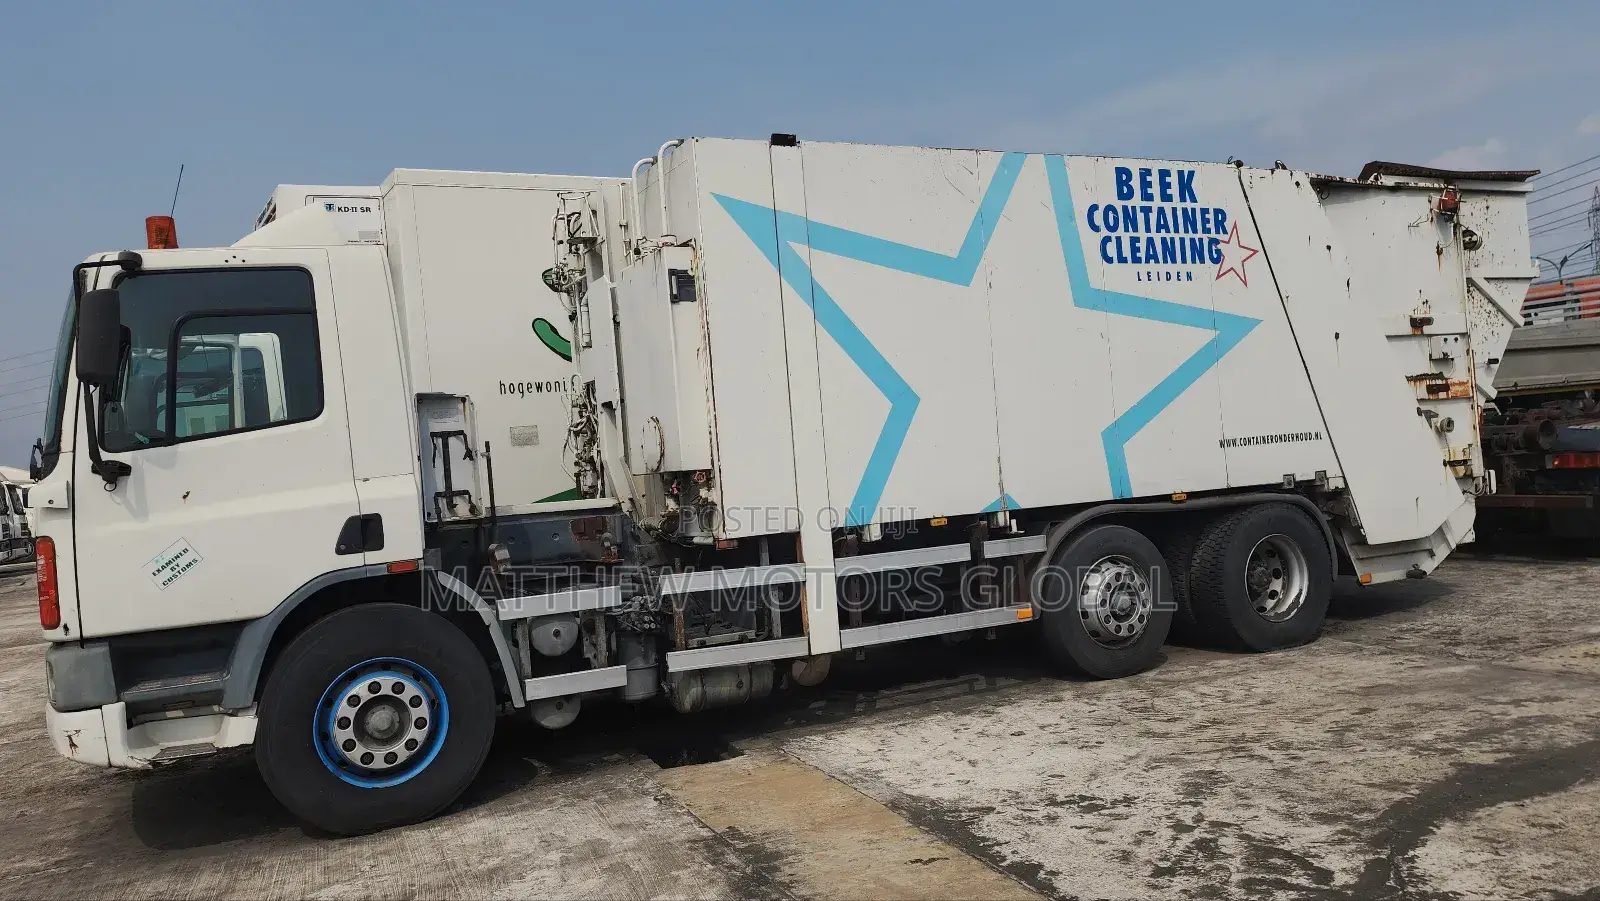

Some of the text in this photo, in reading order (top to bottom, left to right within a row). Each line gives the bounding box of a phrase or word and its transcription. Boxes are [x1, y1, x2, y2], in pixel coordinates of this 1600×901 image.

[1114, 166, 1198, 204] BEEK
[1086, 203, 1229, 235] CONTAINER
[1100, 235, 1223, 265] CLEANING
[1137, 271, 1193, 282] LEIDEN
[1218, 431, 1323, 449] WWW.CONTAINERONDERHOUD.NL
[152, 548, 189, 576] EXAMINED
[162, 558, 198, 586] CUSTOMS
[169, 562, 180, 572] BY
